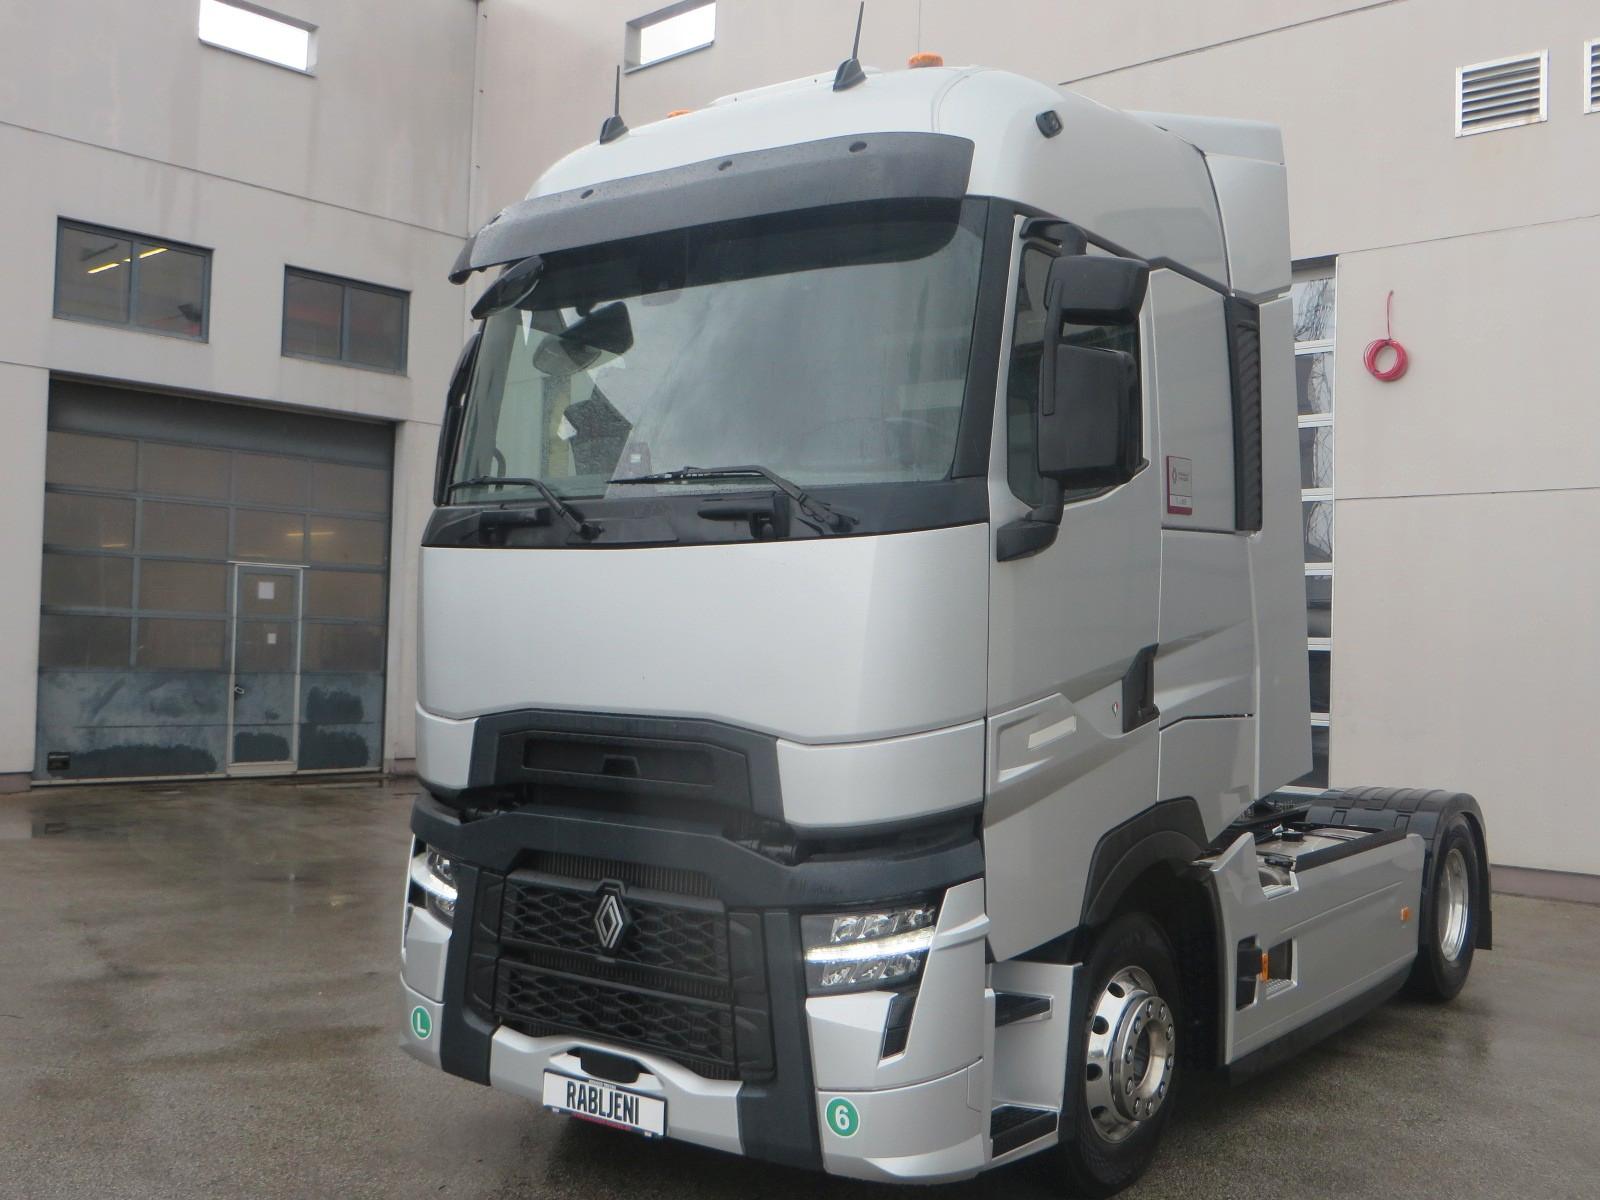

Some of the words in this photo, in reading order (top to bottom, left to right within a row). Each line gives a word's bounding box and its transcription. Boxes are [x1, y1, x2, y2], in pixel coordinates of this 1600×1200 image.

[417, 1012, 427, 1034] L
[566, 1080, 640, 1125] RABLJENI
[835, 1104, 850, 1130] 6
